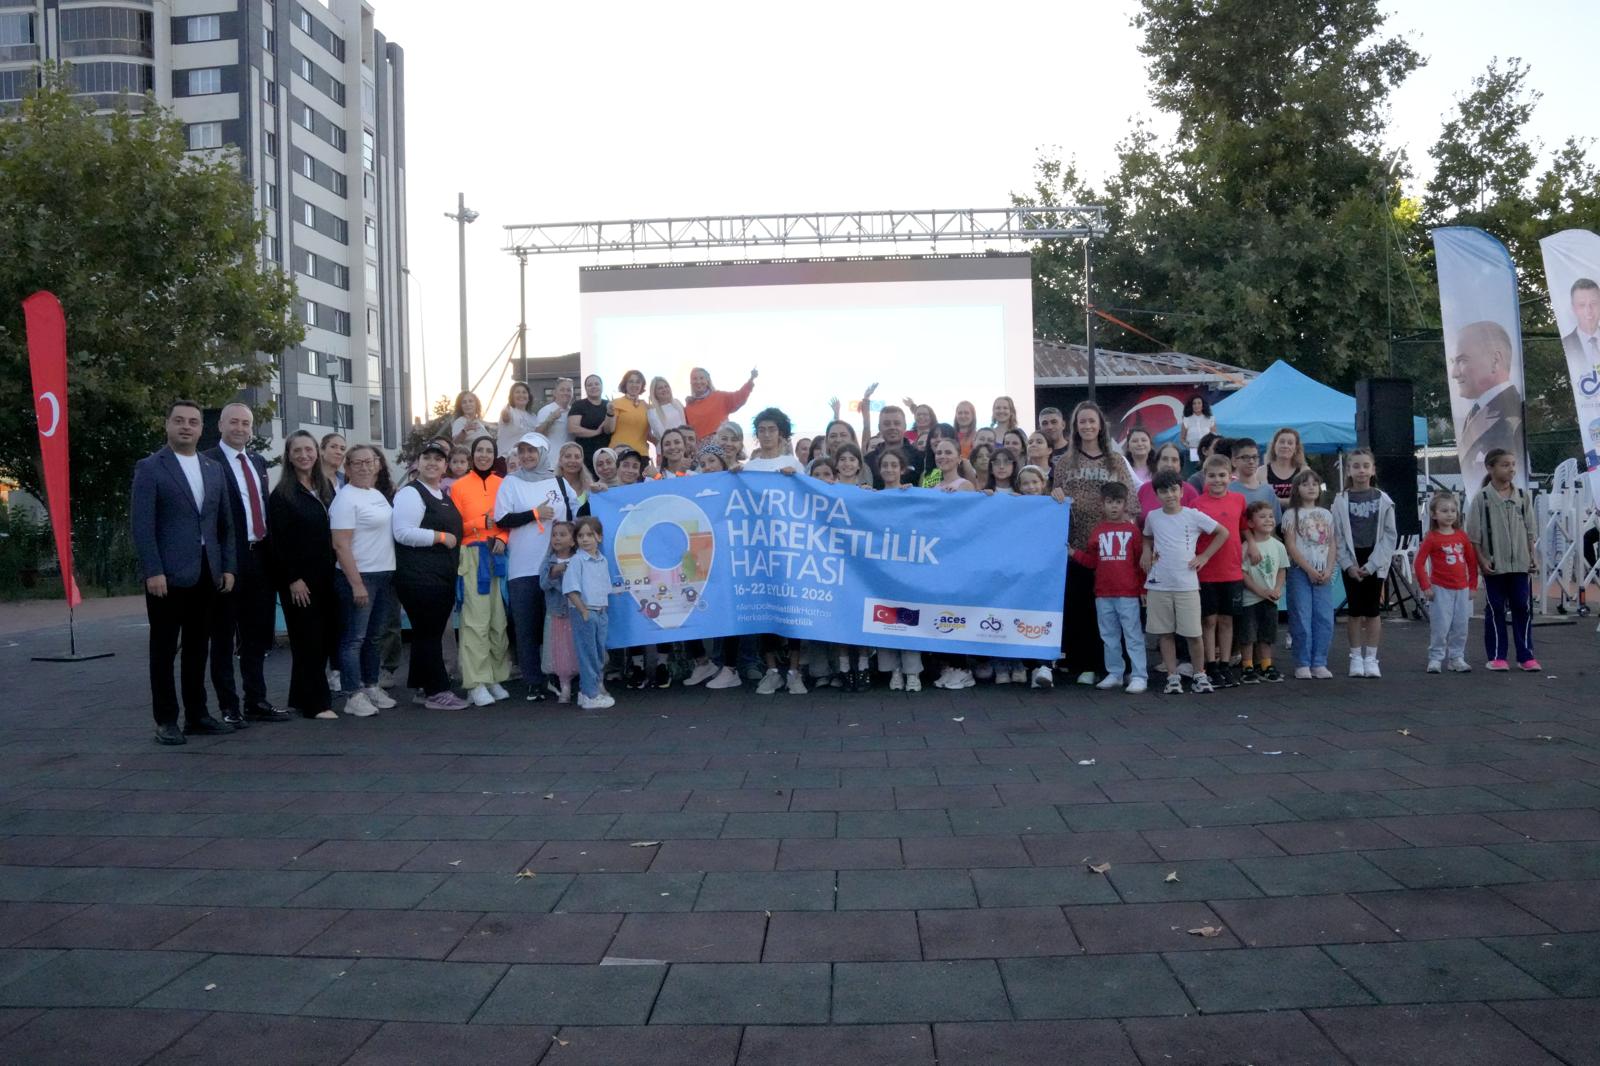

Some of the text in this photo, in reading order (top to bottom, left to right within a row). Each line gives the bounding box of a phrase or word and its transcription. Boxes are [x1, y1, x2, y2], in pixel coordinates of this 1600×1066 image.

[725, 488, 851, 526] AVRUPA
[727, 519, 941, 565] HAREKETLİLİK
[1098, 531, 1133, 557] NY
[730, 550, 845, 586] HAFTASI
[734, 583, 833, 602] 16-22 EYLÜL 2026
[940, 616, 966, 624] aces
